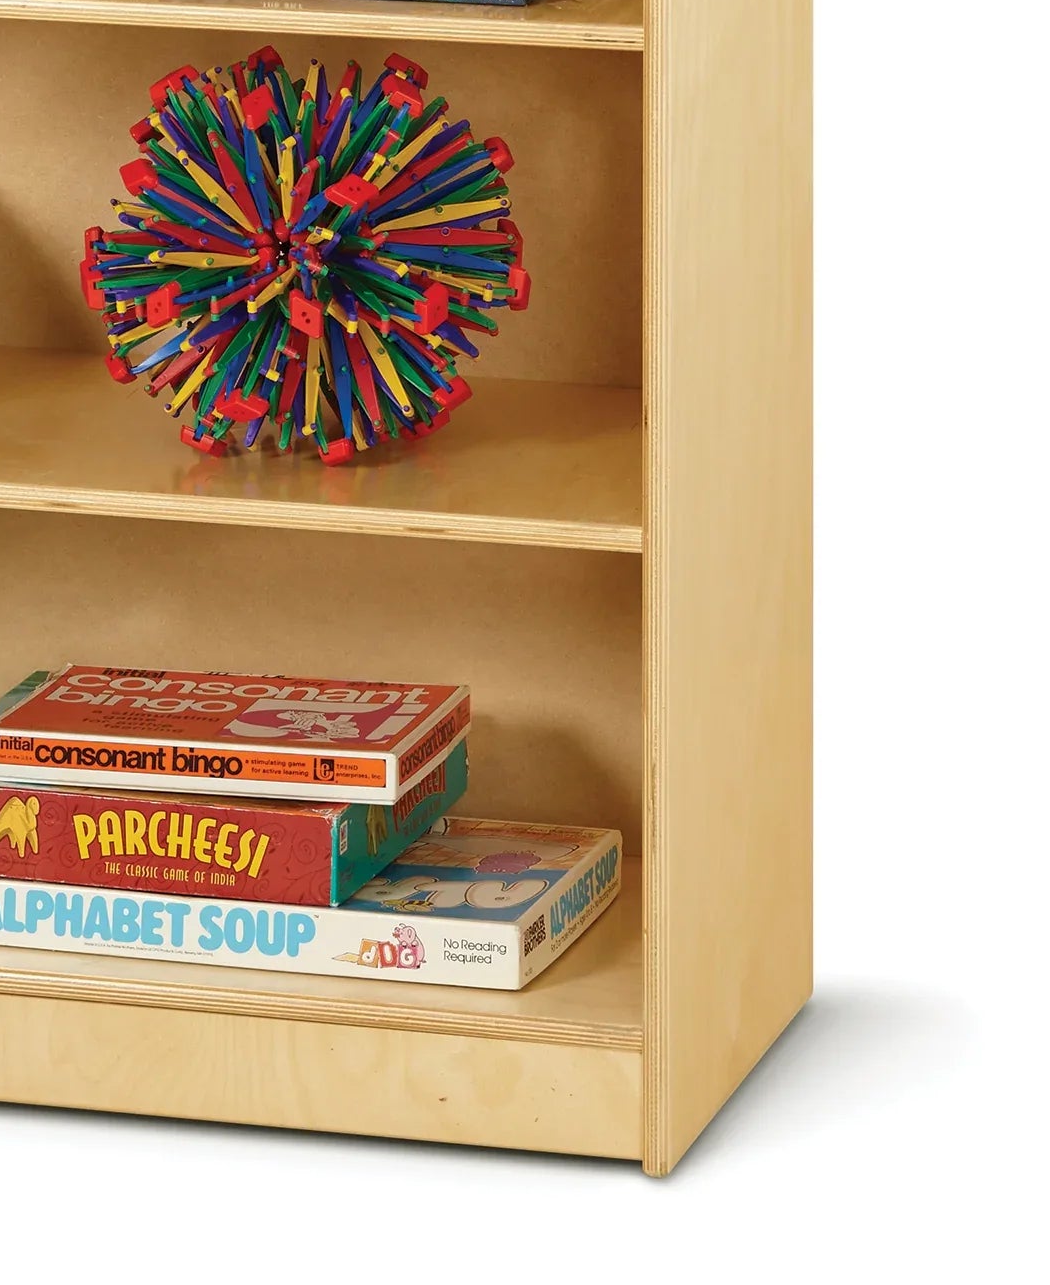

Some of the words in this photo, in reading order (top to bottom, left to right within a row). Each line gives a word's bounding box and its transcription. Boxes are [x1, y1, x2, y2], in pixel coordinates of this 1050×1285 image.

[45, 686, 238, 714] bingo
[66, 674, 430, 704] consonant
[35, 744, 166, 771] consonant
[172, 746, 243, 778] bingo
[251, 759, 286, 768] stimulating
[283, 769, 309, 778] learning
[72, 809, 271, 879] PARCHEESI
[104, 861, 120, 875] THE
[125, 863, 158, 879] CLASSIC
[163, 868, 189, 882] GAME
[194, 871, 206, 884] OF
[210, 873, 236, 886] INDIA
[550, 869, 595, 939] ALPHABET
[595, 844, 618, 892] SOUP
[197, 904, 317, 958] SOUP
[443, 938, 460, 950] No
[460, 939, 507, 955] Reading
[443, 950, 492, 964] Required
